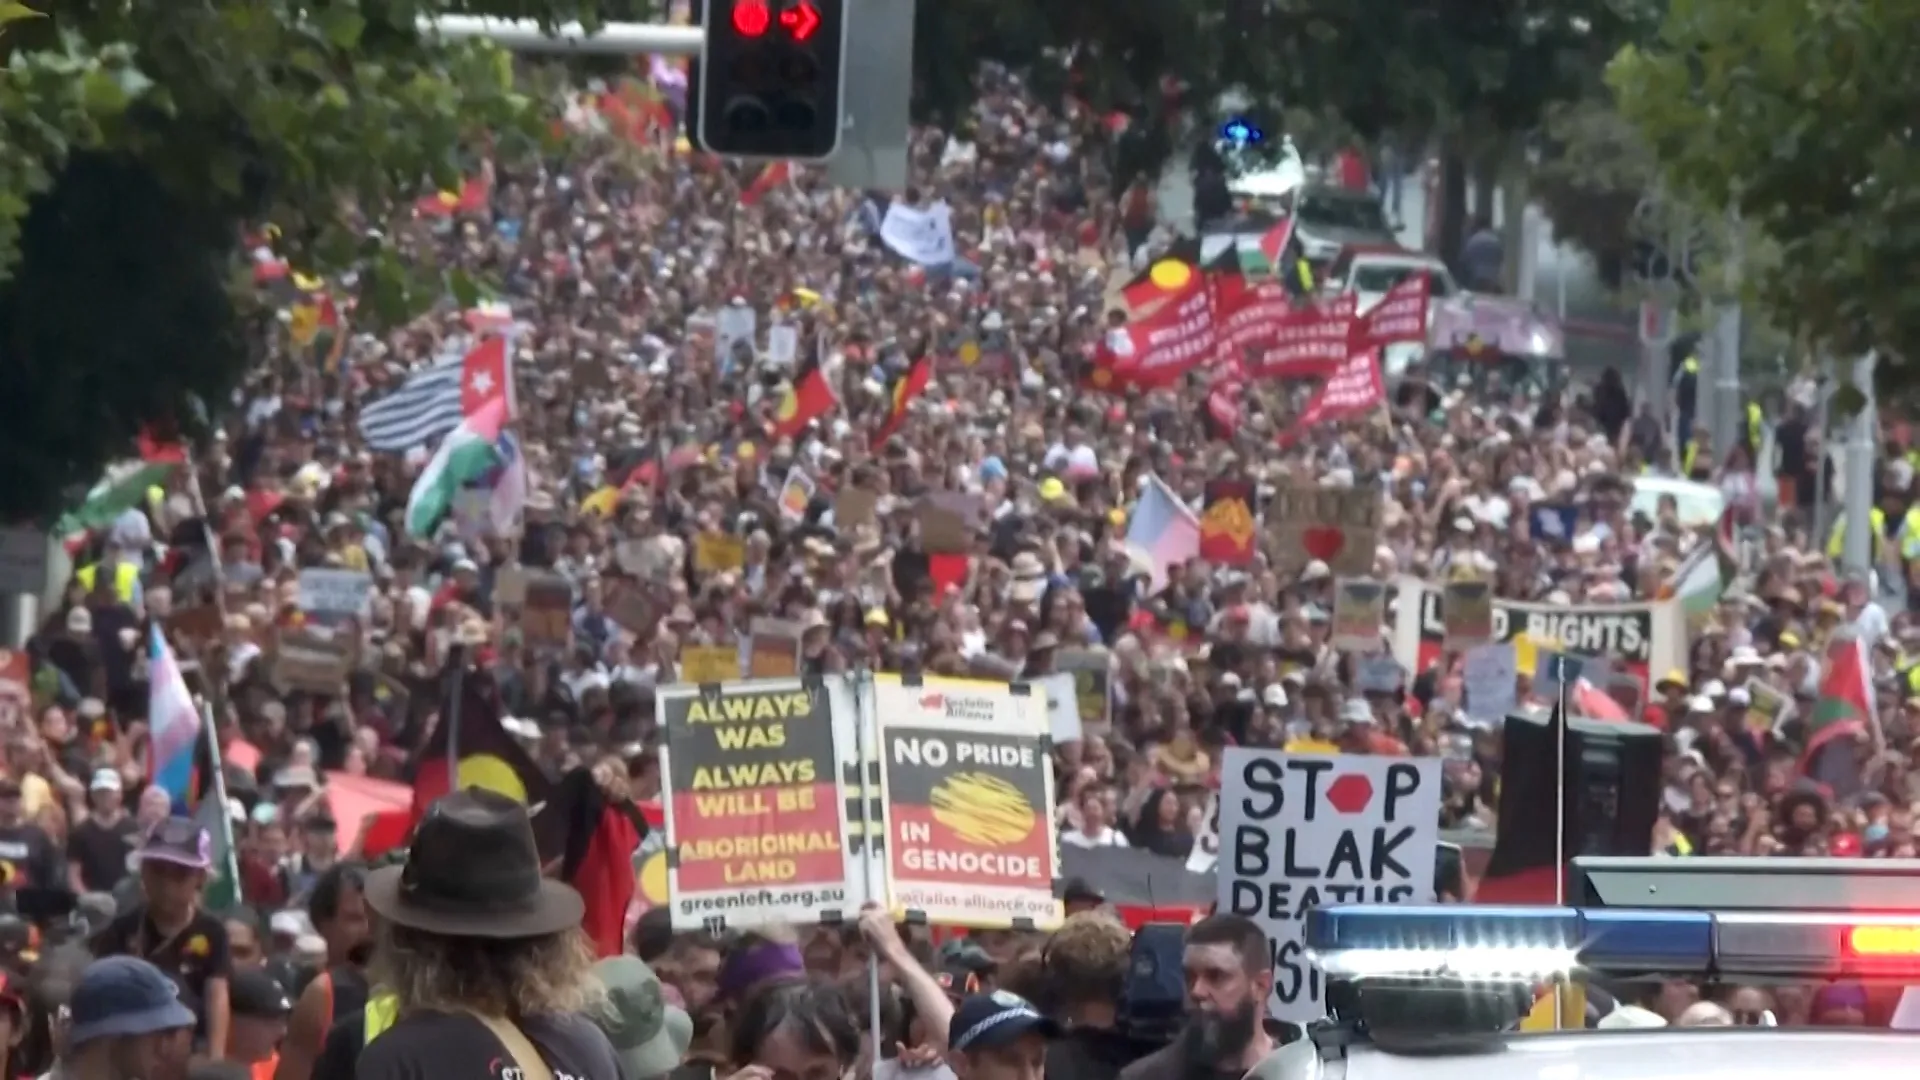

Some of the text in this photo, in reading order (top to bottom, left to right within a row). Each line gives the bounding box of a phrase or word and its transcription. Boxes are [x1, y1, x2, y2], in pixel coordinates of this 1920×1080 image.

[687, 692, 811, 723] ALWAYS
[945, 708, 993, 721] Alliance
[715, 724, 786, 750] WAS
[894, 737, 1035, 769] NO PRIDE
[692, 759, 816, 790] ALWAYS
[696, 786, 816, 818] WILL BE
[679, 831, 841, 862] ABORIGINAL
[900, 820, 930, 843] IN
[902, 848, 1041, 878] GENOCIDE
[1234, 825, 1416, 880] BLAK
[724, 859, 796, 883] LAND
[680, 887, 845, 915] greenleft.org.au
